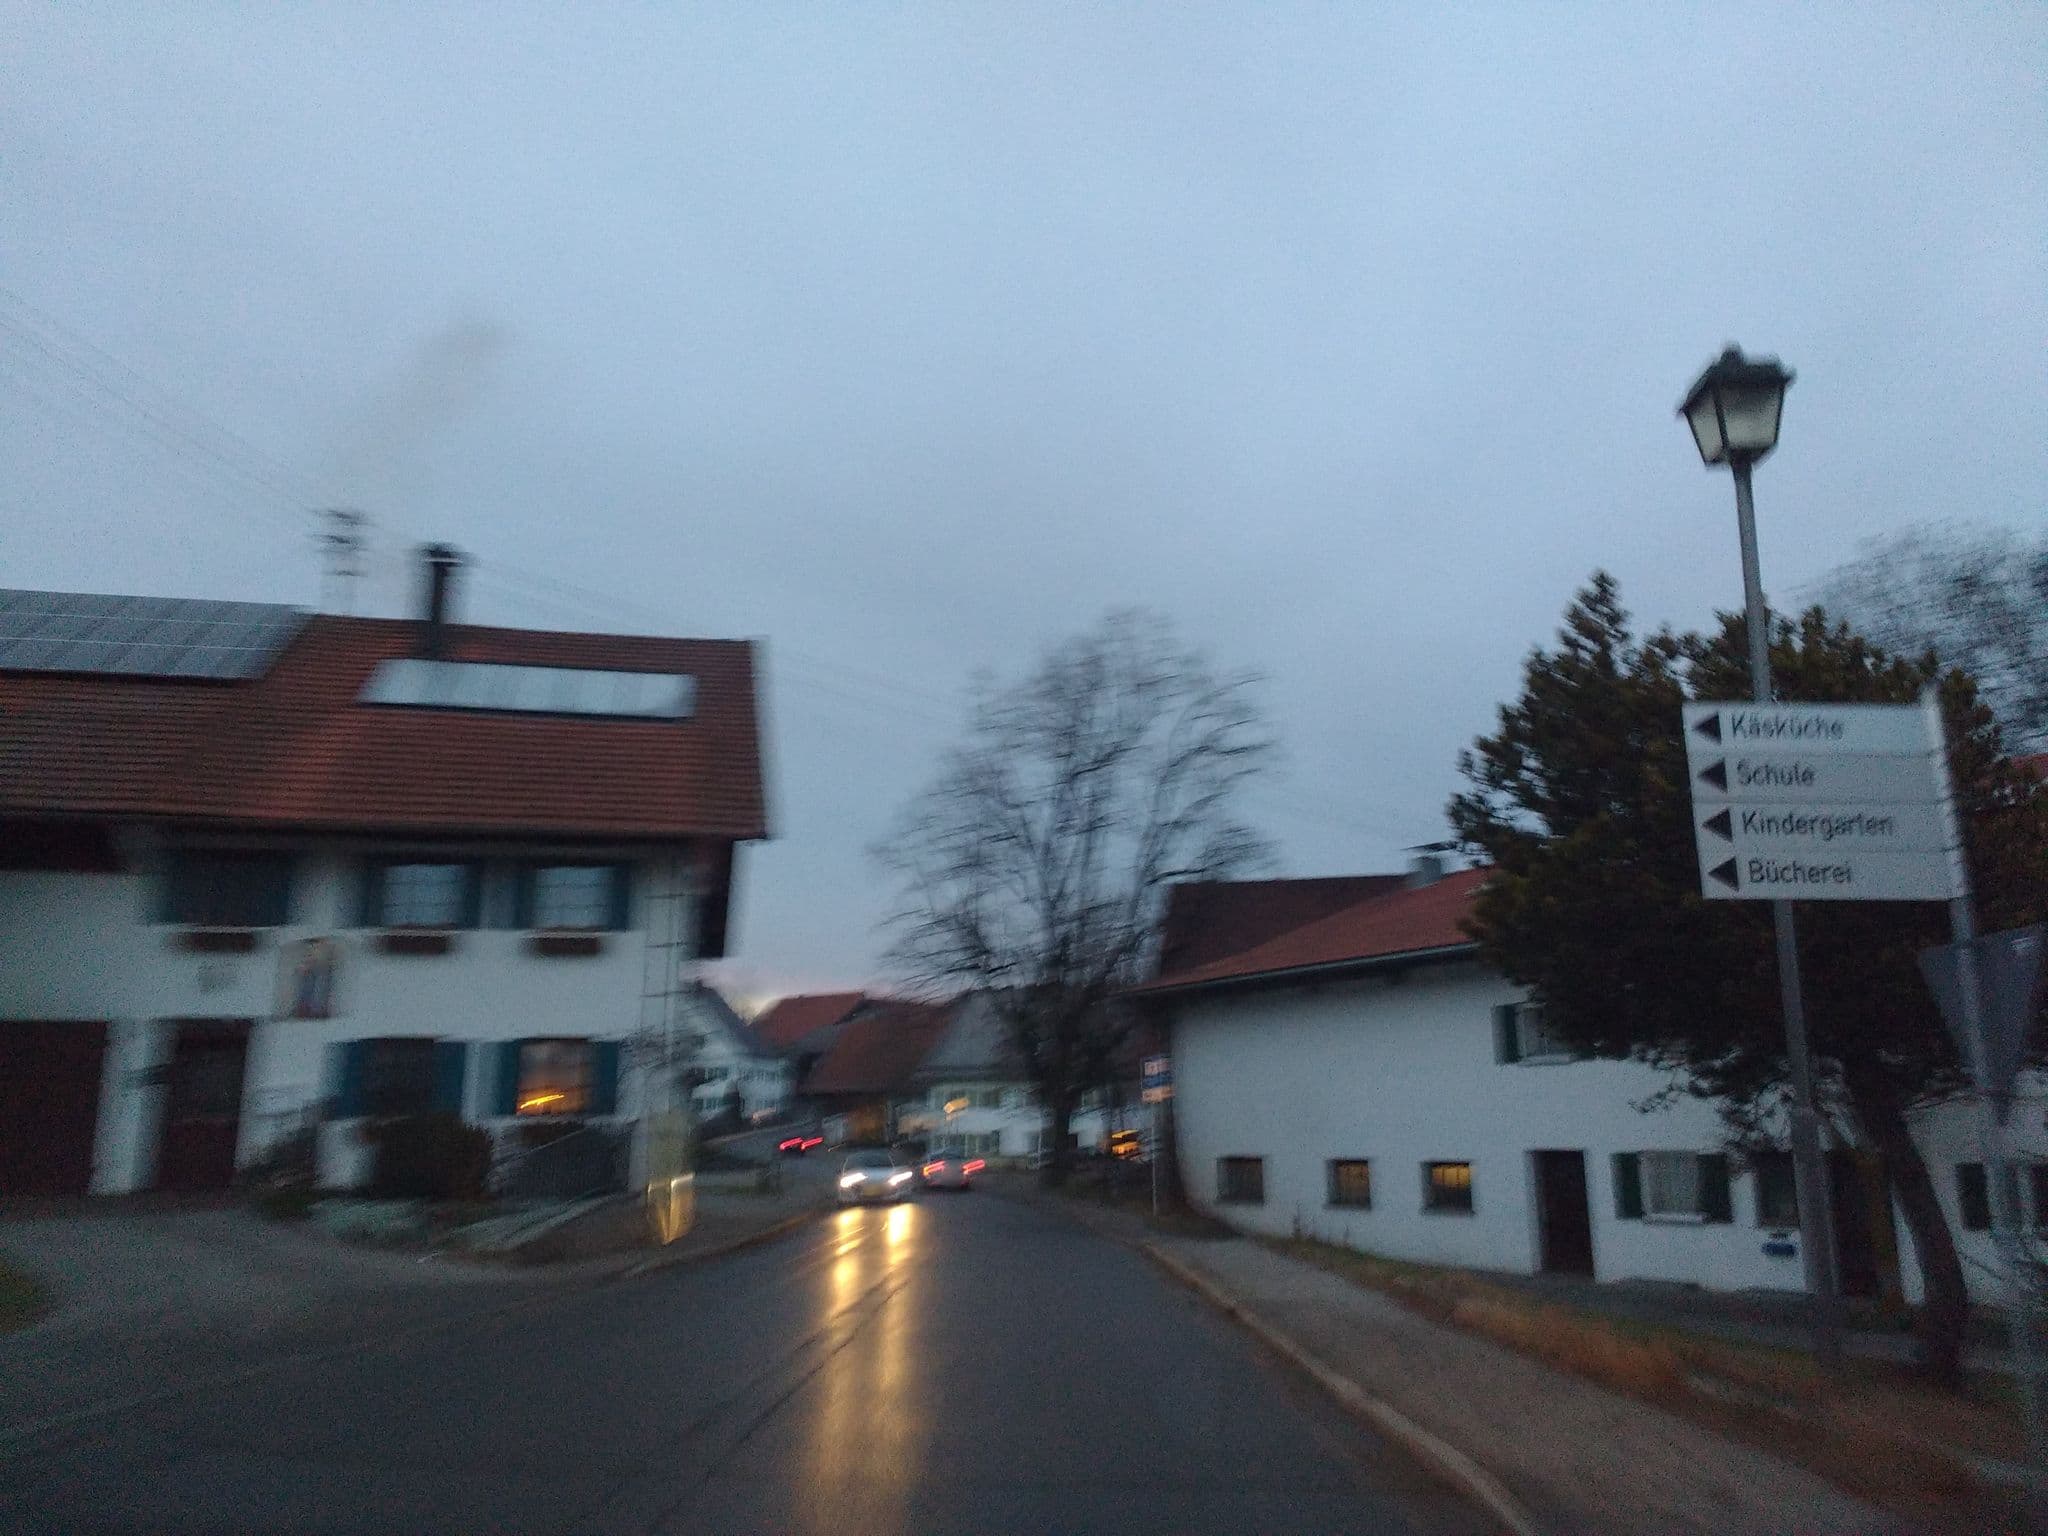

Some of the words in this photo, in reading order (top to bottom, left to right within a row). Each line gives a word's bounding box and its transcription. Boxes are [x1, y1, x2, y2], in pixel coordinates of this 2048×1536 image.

[1736, 759, 1815, 786] Schule
[1742, 810, 1893, 840] Kindergarten
[1749, 859, 1852, 885] Bücherei
